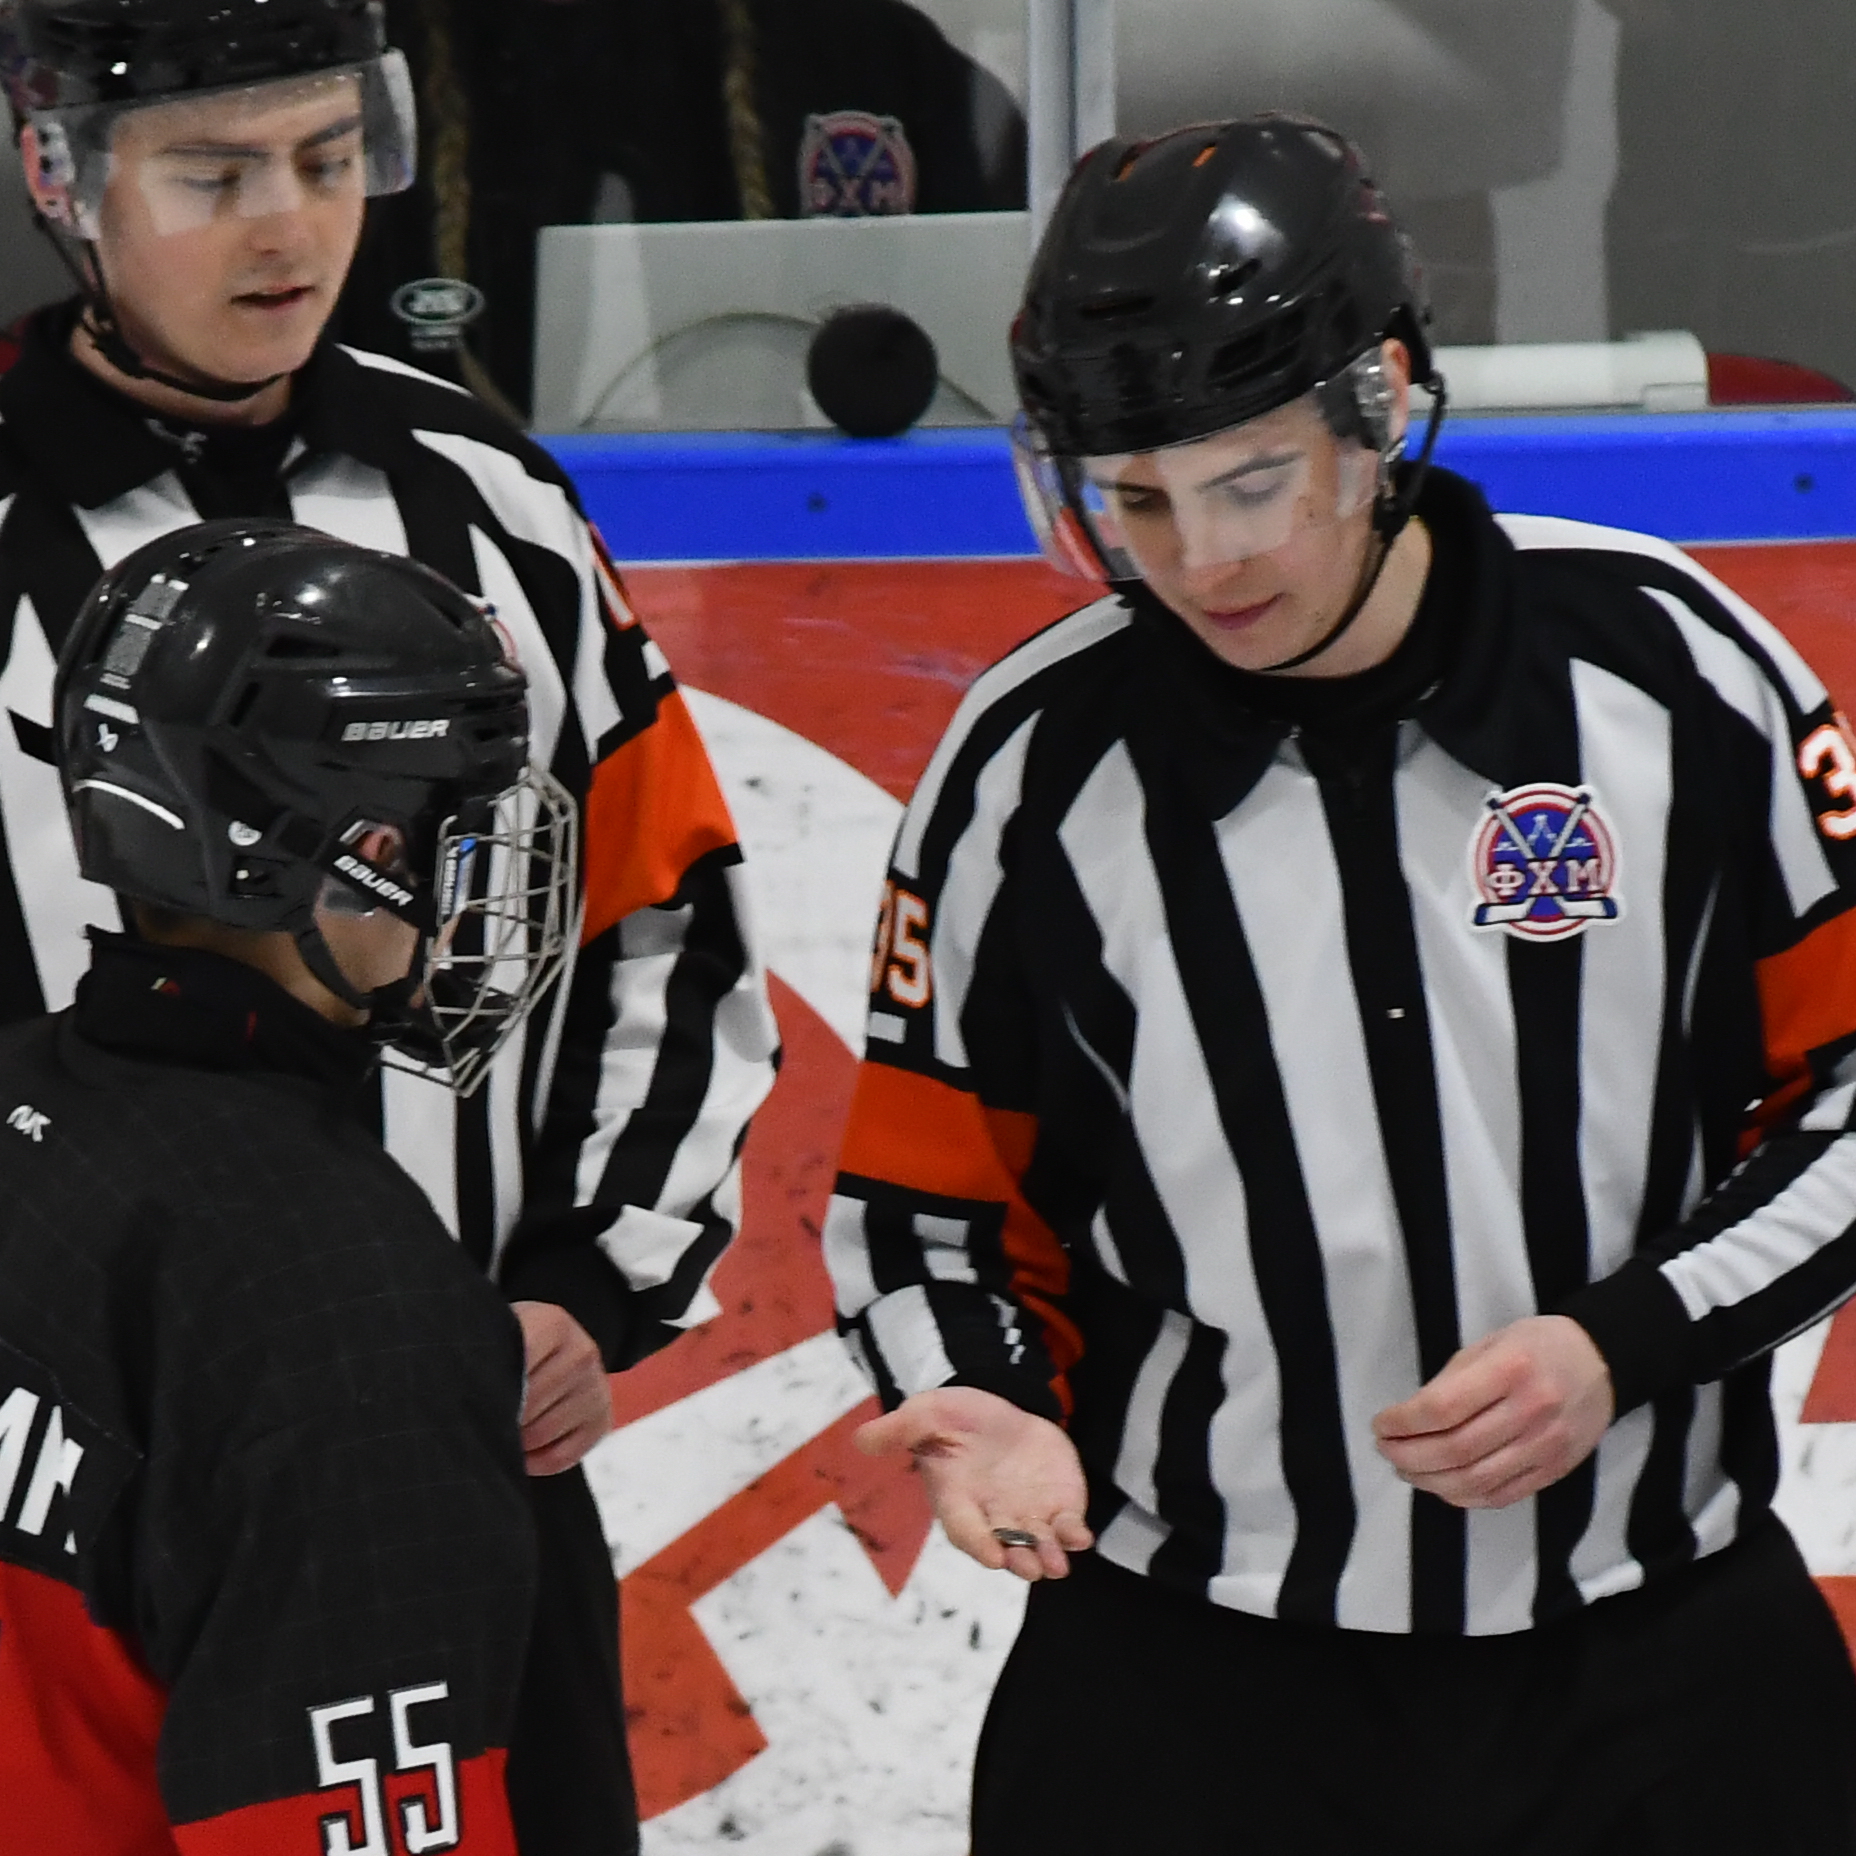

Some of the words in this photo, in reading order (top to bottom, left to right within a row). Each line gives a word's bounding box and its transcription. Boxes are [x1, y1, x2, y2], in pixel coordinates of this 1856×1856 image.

[341, 718, 450, 742] BAUER
[332, 854, 415, 907] BAUER
[1484, 857, 1606, 898] ФХМ
